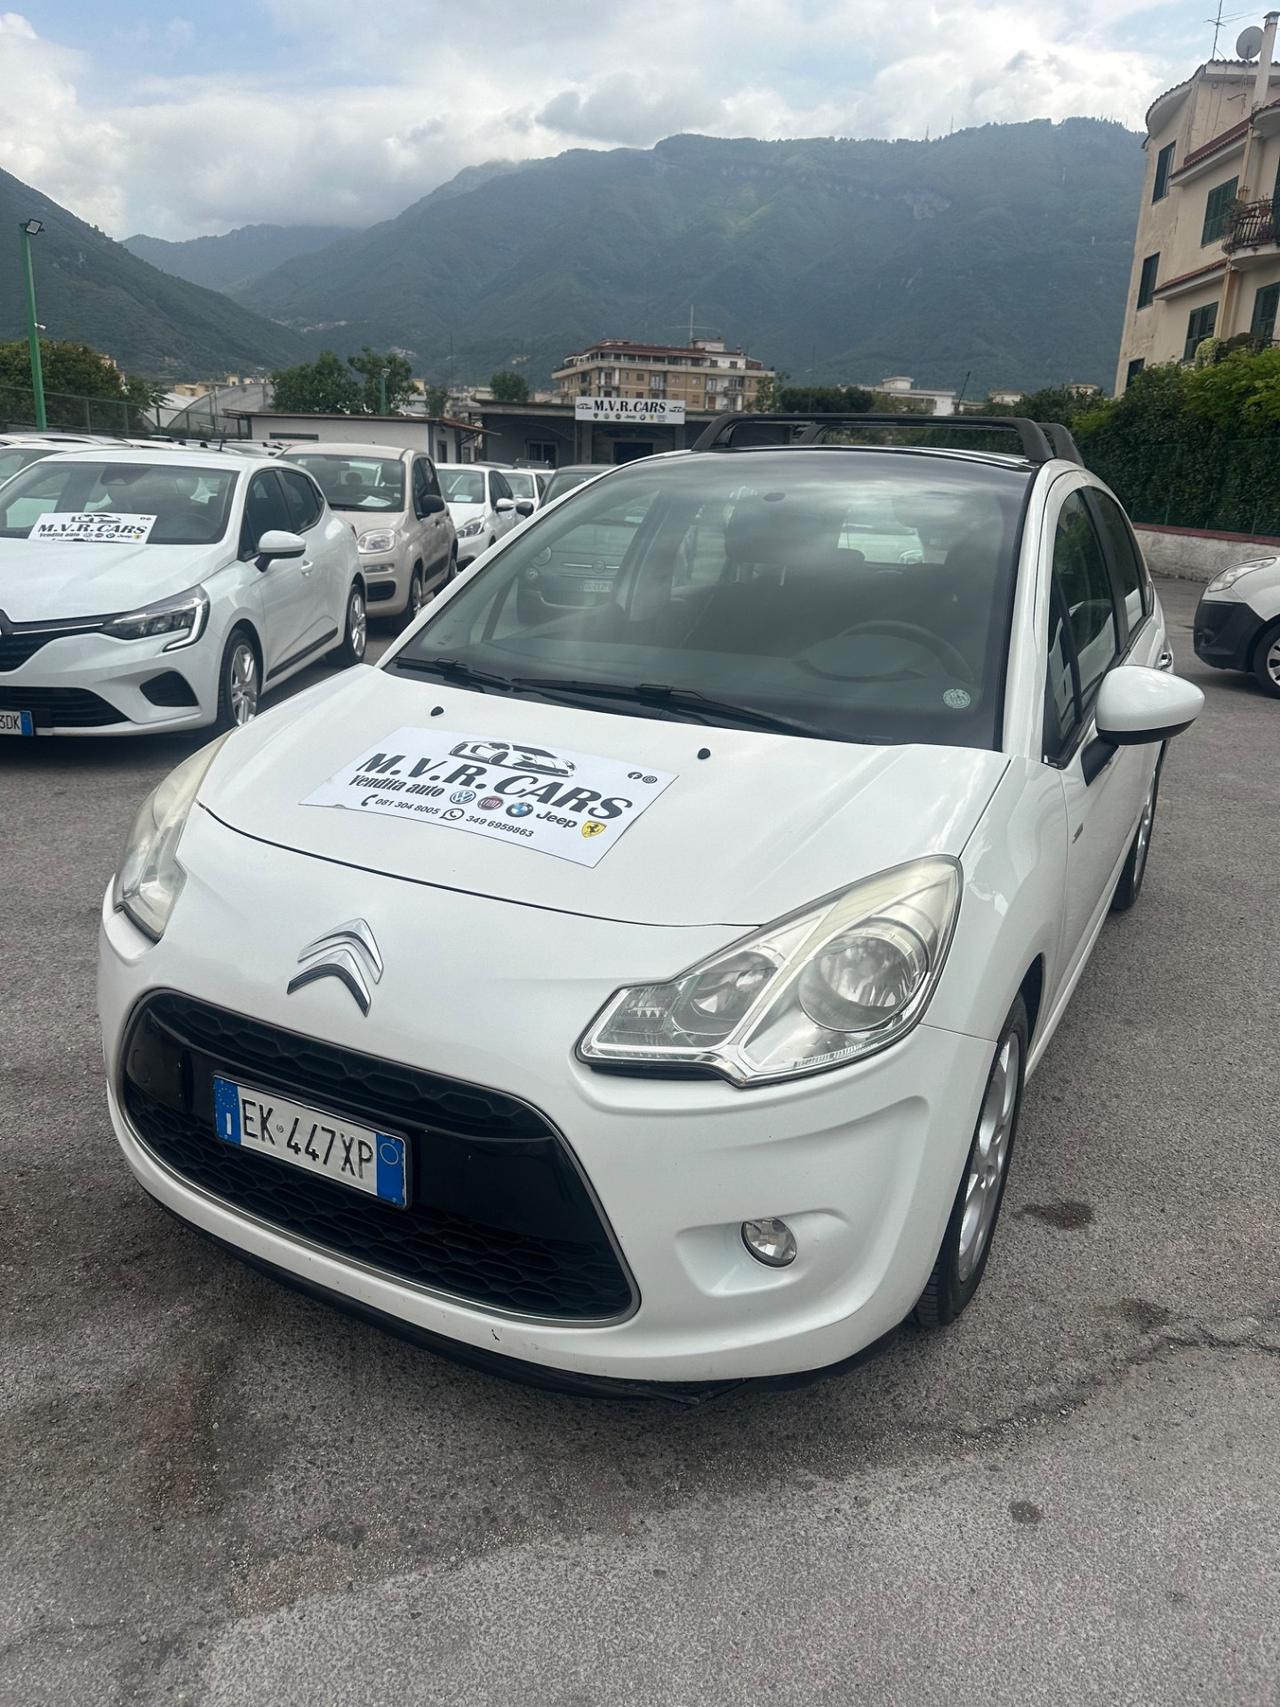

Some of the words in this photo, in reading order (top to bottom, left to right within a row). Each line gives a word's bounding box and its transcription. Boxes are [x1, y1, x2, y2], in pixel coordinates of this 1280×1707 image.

[349, 774, 407, 791] Vendita
[406, 782, 445, 797] auto
[536, 811, 578, 829] Jeep
[375, 798, 392, 807] 081
[394, 802, 412, 810] 304
[414, 804, 441, 815] 8005
[466, 815, 486, 826] 349
[487, 819, 534, 838] 6959863
[226, 1113, 232, 1135] I
